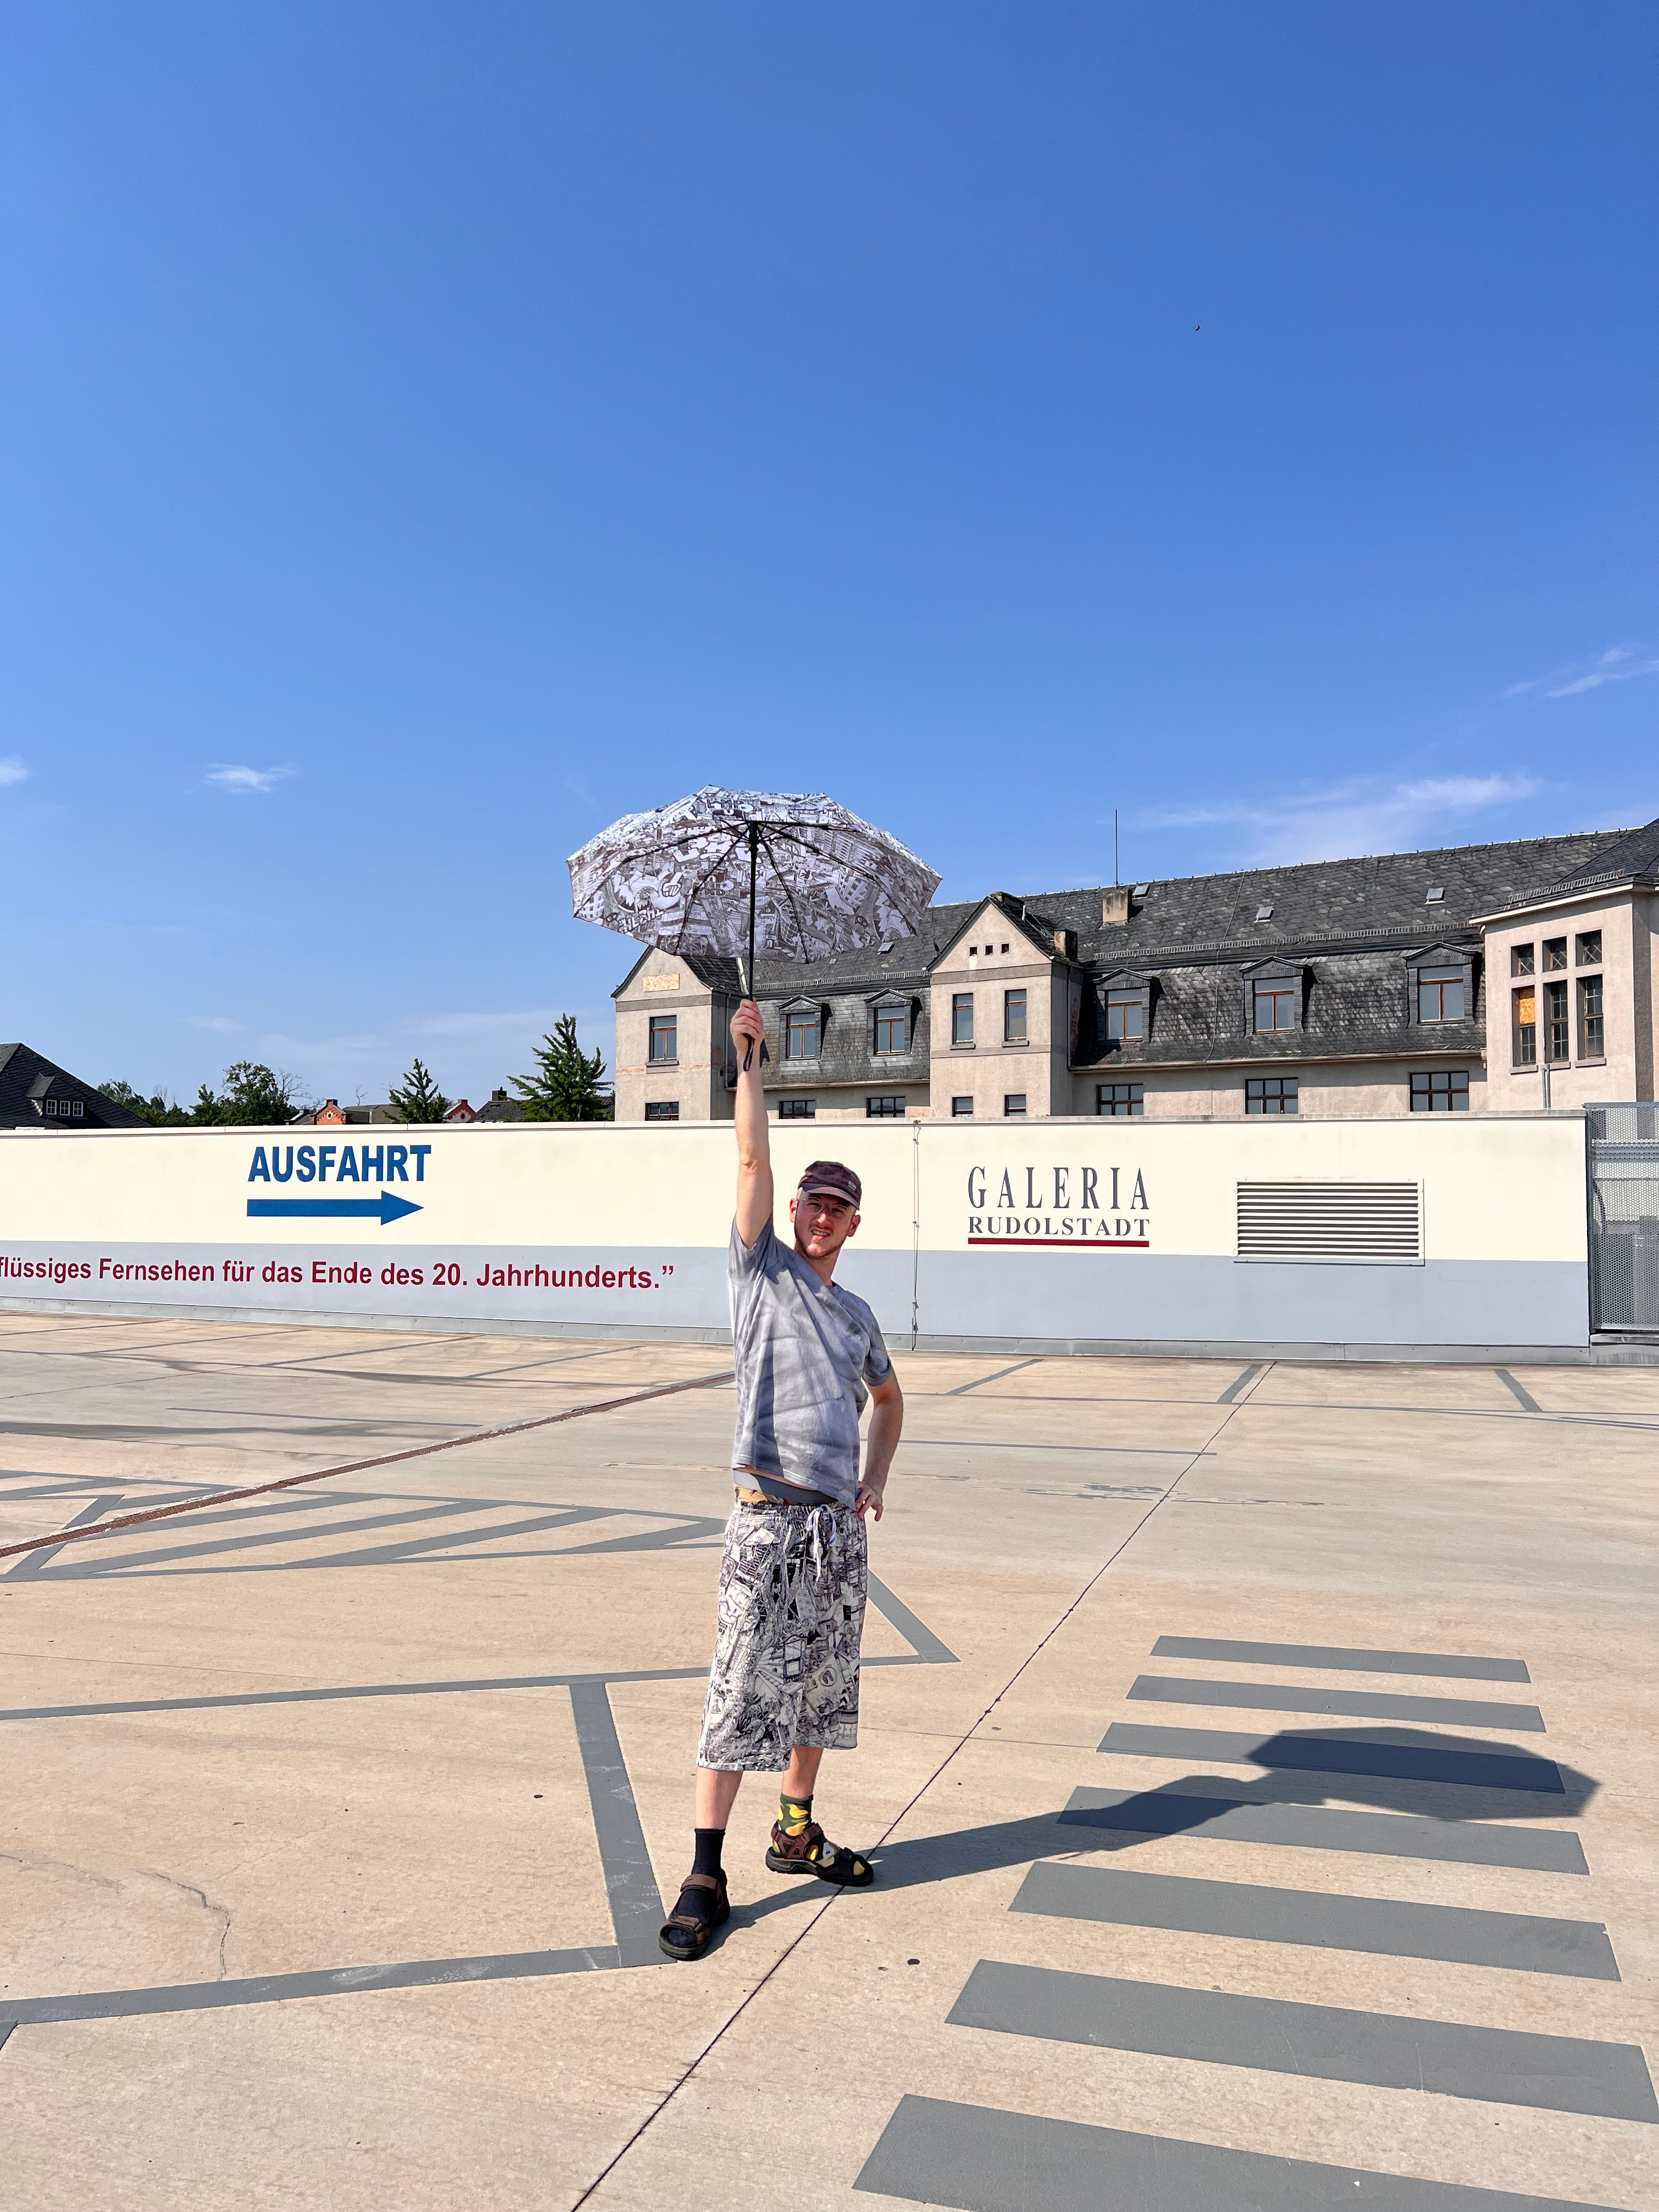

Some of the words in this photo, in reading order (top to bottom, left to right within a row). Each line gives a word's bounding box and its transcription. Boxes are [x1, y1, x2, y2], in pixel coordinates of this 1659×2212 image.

[249, 1145, 432, 1182] AUSFAHRT
[968, 1166, 1150, 1210] GALERIA
[968, 1216, 1150, 1237] RUDOLSTADT
[99, 1259, 215, 1282] Fernsehen
[222, 1260, 255, 1282] für
[262, 1261, 303, 1283] das
[312, 1261, 372, 1284] Ende
[381, 1263, 424, 1285] des
[432, 1263, 467, 1286] 20.
